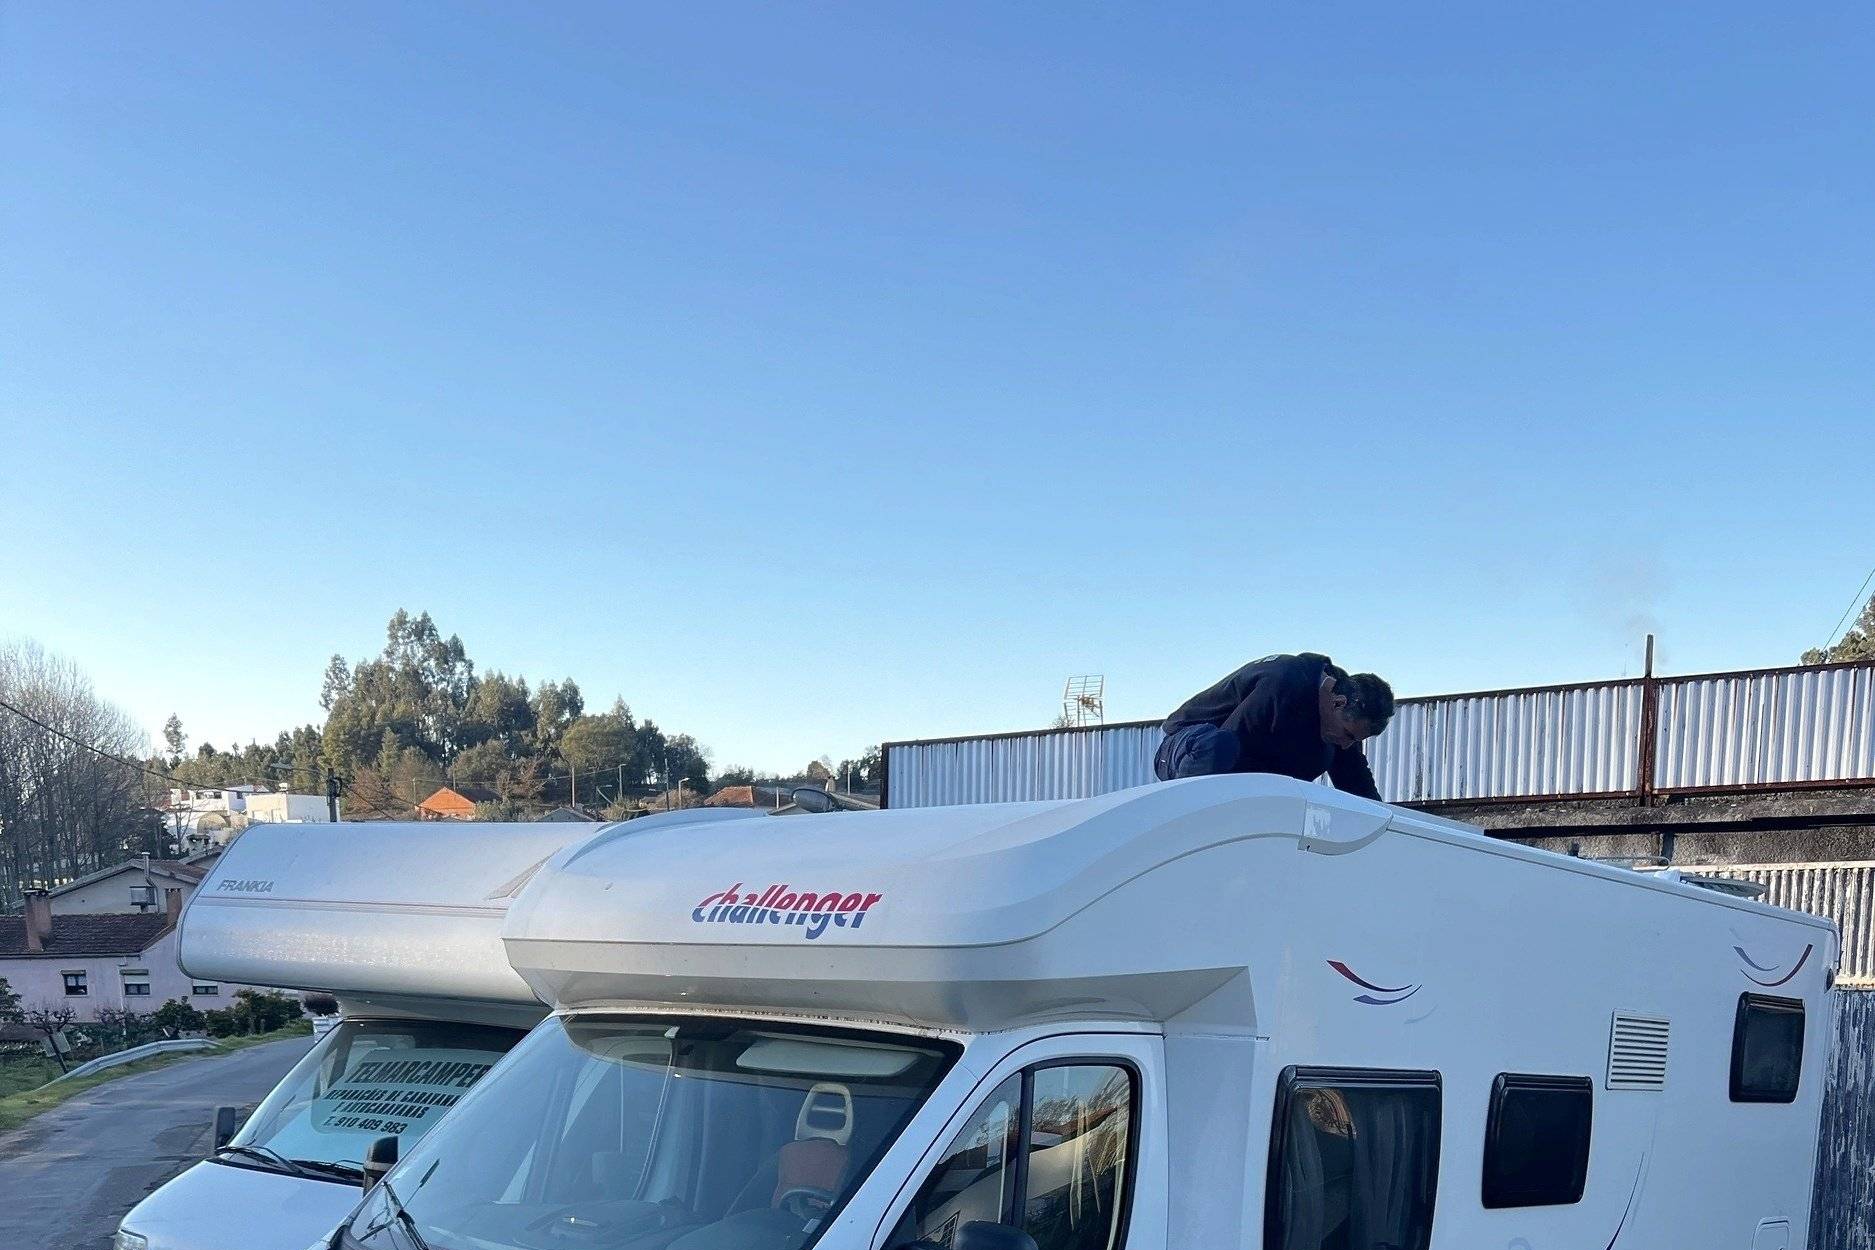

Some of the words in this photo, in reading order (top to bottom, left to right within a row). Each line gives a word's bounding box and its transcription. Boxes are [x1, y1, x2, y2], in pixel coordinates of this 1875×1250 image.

[216, 879, 275, 892] FRANKIA
[691, 882, 884, 940] challenger
[386, 1091, 405, 1102] DE
[335, 1117, 357, 1128] 910
[357, 1119, 381, 1131] 409
[380, 1121, 408, 1134] 983
